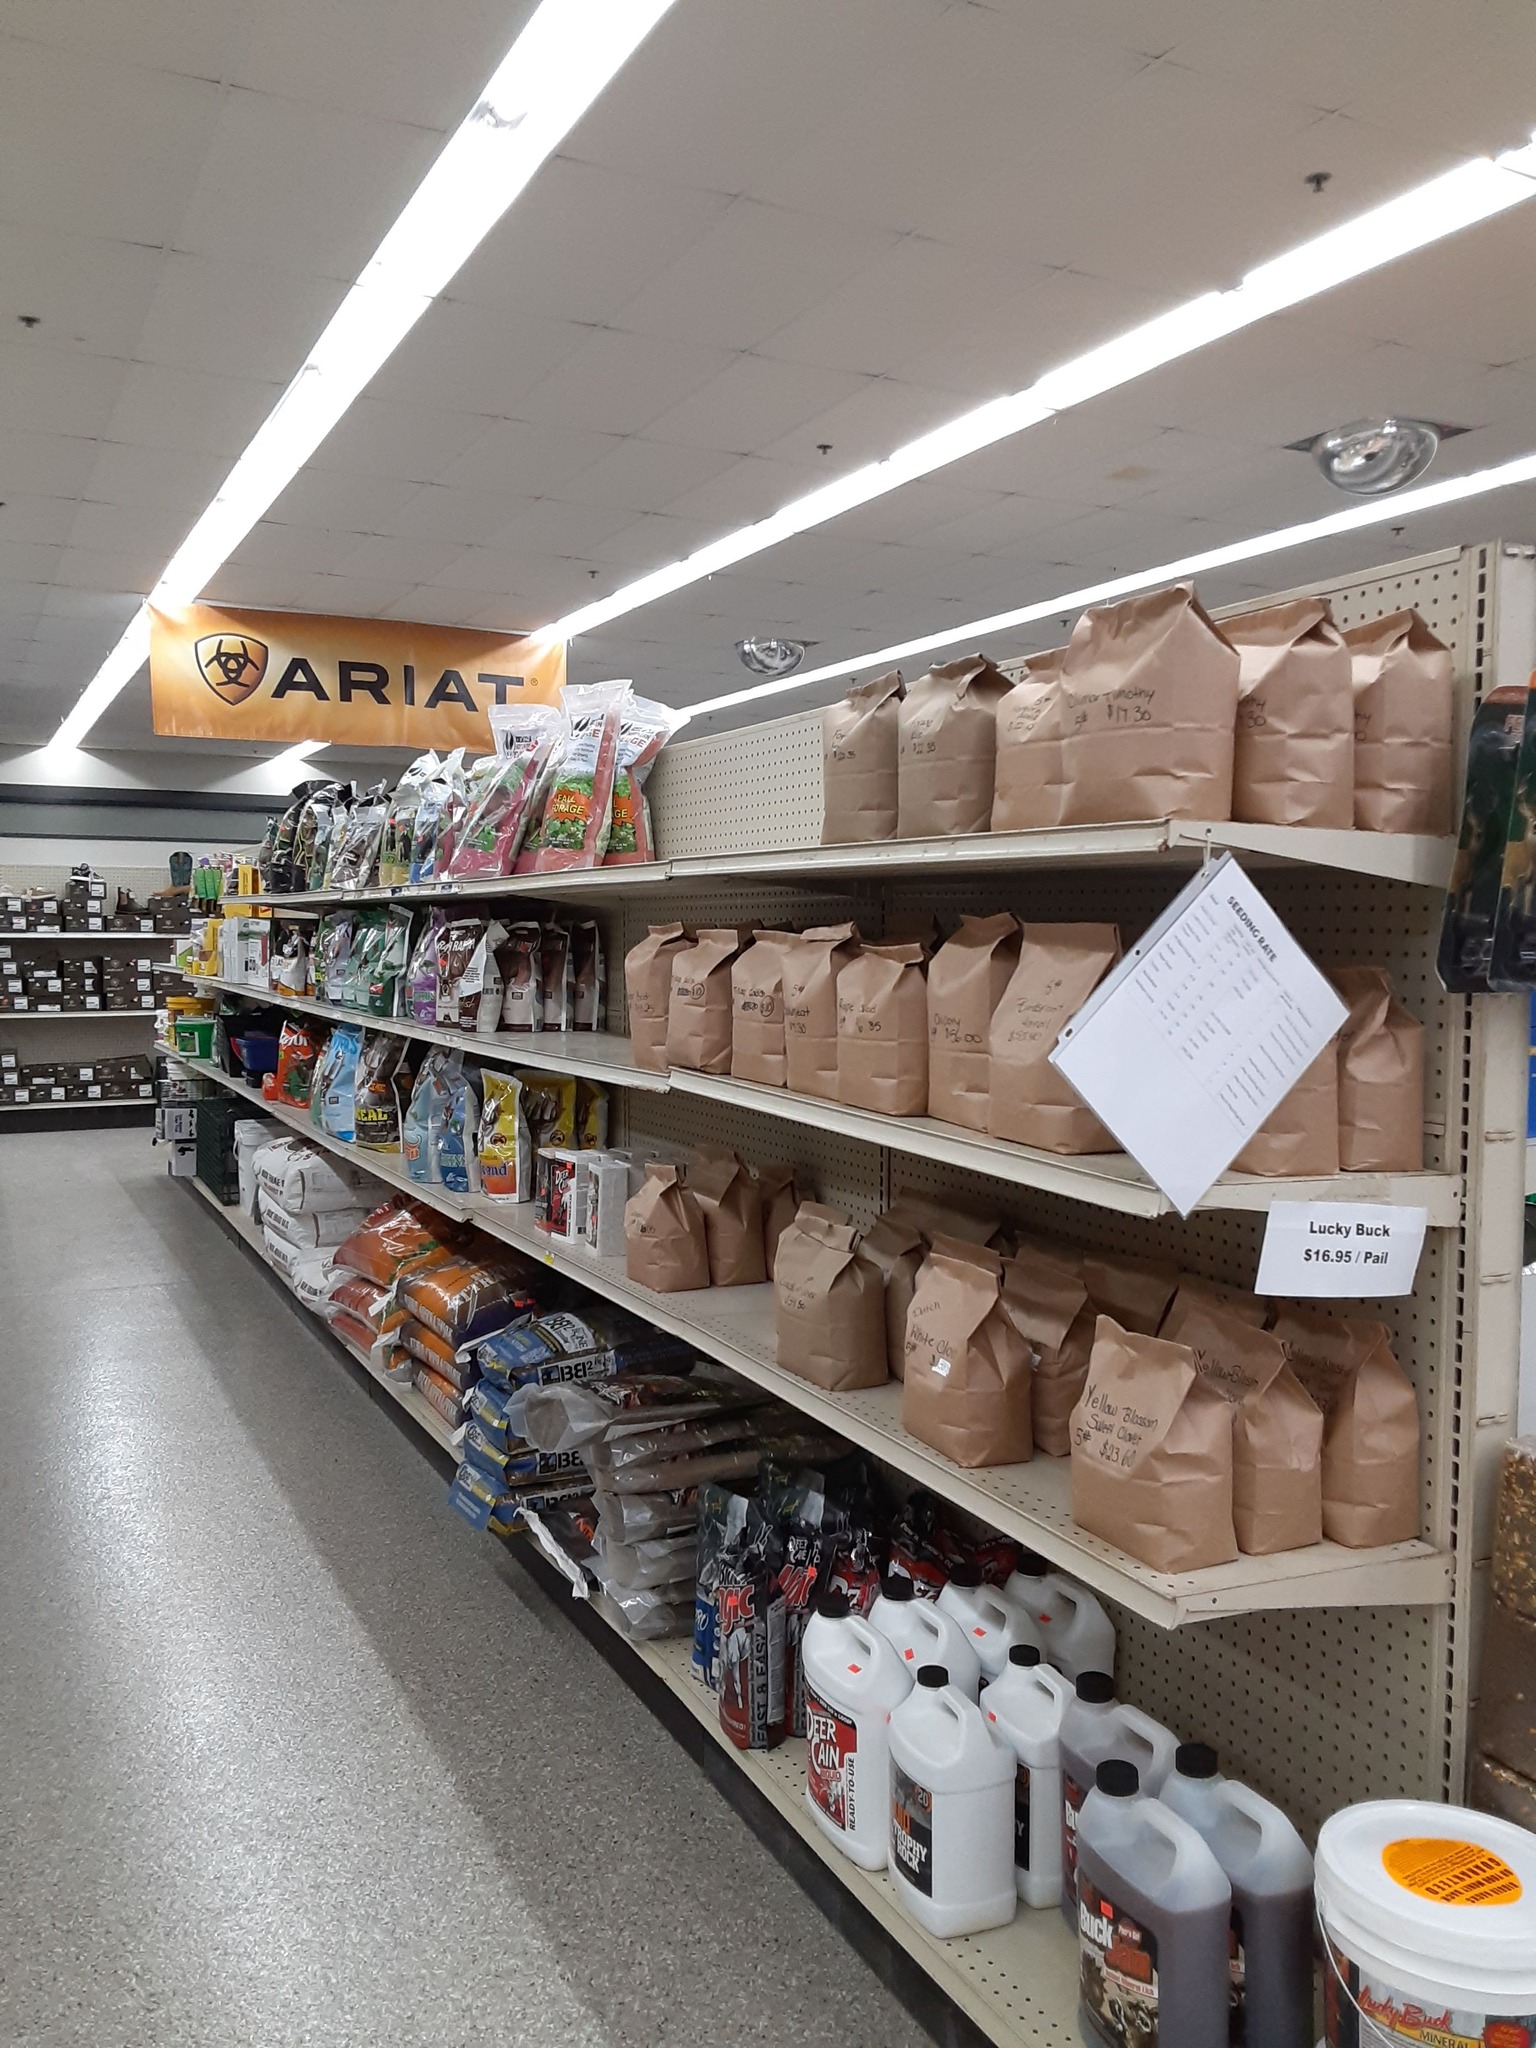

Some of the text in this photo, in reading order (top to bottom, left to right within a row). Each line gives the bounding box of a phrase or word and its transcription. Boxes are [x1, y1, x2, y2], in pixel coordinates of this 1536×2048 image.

[271, 656, 524, 713] ARIAT
[1227, 895, 1278, 962] SEEDING RATE
[1309, 1221, 1390, 1238] Lucky Buck
[1303, 1248, 1388, 1264] $16.95 / Pail
[1085, 1384, 1159, 1432] Yellow Blossom
[1075, 1427, 1092, 1446] 5#
[756, 1632, 766, 1678] EASY
[757, 1702, 767, 1743] FAST
[806, 1703, 837, 1742] DEER
[811, 1735, 840, 1776] CAIN
[847, 1757, 857, 1832] READY-TO-USE
[917, 1788, 929, 1808] 20
[893, 1816, 928, 1863] TROPHY
[896, 1839, 920, 1874] ROCK
[1425, 1857, 1502, 1896] GUARANTEED
[1359, 1984, 1451, 2034] Lucky Buck
